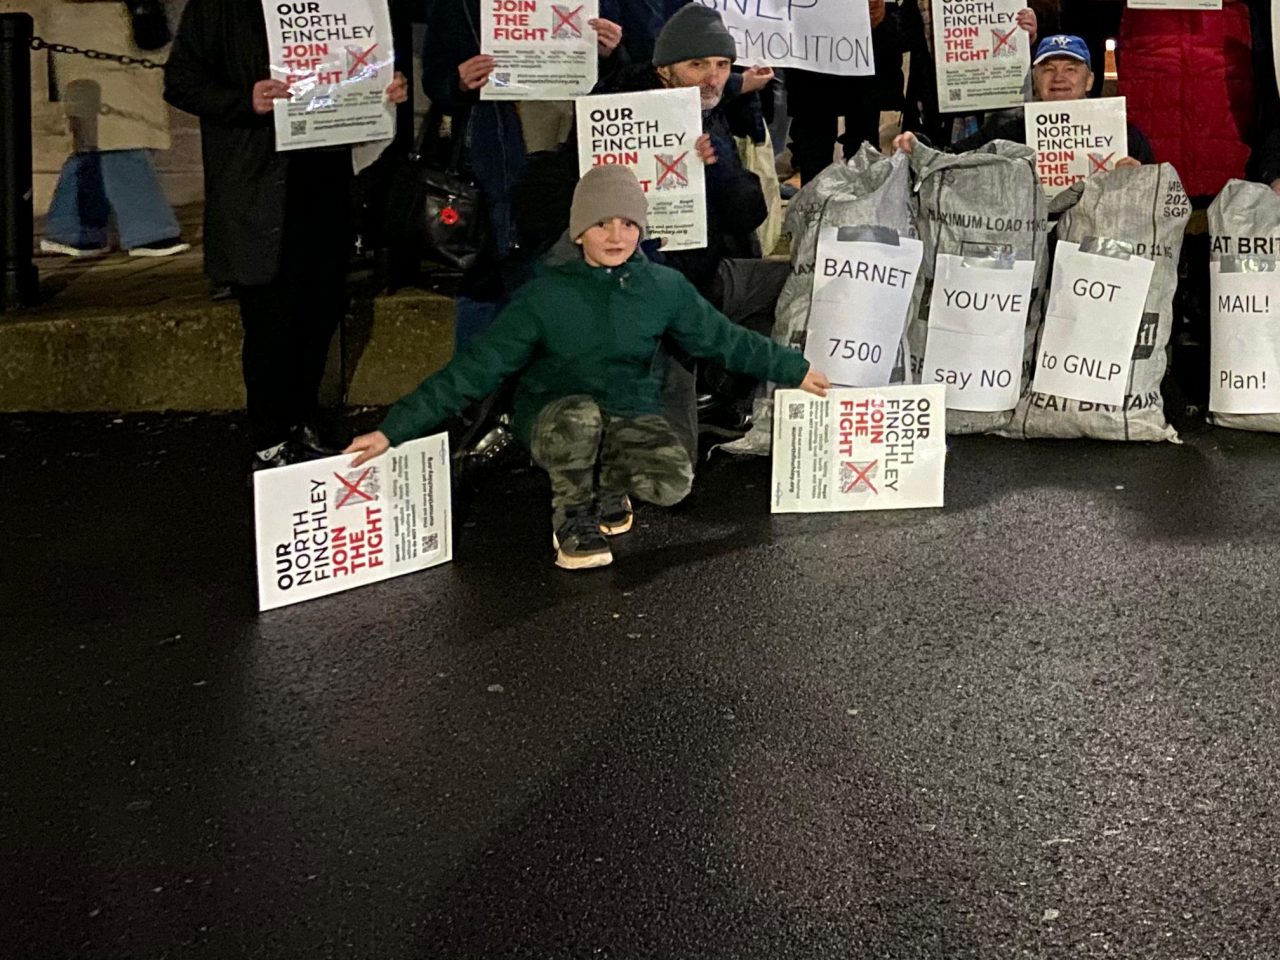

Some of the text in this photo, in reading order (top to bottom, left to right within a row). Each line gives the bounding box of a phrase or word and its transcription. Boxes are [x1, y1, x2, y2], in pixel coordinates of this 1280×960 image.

[277, 2, 320, 15] OUR
[493, 0, 536, 12] JOIN
[943, 2, 994, 15] NORTH
[280, 13, 347, 29] NORTH
[493, 14, 529, 26] THE
[944, 12, 1015, 27] FINCHLEY
[282, 25, 374, 43] FINCHLEY
[493, 28, 548, 41] FIGHT
[944, 27, 979, 39] JOIN
[282, 42, 329, 58] JOIN
[728, 26, 870, 68] EMOLITION
[944, 39, 974, 50] THE
[946, 49, 989, 63] FIGHT
[590, 108, 633, 123] OUR
[1036, 113, 1070, 126] OUR
[591, 120, 659, 137] NORTH
[1037, 124, 1091, 138] NORTH
[592, 132, 686, 152] FINCHLEY
[1037, 136, 1113, 151] FINCHLEY
[592, 152, 638, 166] JOIN
[1037, 150, 1074, 163] JOIN
[1037, 163, 1069, 175] THE
[986, 216, 1022, 232] LOAD
[823, 257, 912, 290] BARNET
[1072, 277, 1121, 303] GOT
[943, 288, 1022, 313] YOU'VE
[1218, 295, 1270, 313] MAIL!
[828, 338, 882, 364] 7500
[1041, 350, 1122, 382] to GNLP
[934, 368, 1012, 390] say NO
[1219, 370, 1267, 390] Plan!
[855, 399, 869, 437] THE
[870, 399, 885, 444] JOIN
[917, 398, 930, 439] OUR
[839, 401, 853, 456] FIGHT
[900, 399, 915, 464] NORTH
[884, 400, 900, 492] FINCHLEY
[311, 479, 331, 581] FINCHLEY
[366, 507, 384, 568] FIGHT
[293, 510, 312, 586] NORTH
[331, 526, 348, 577] JOIN
[349, 530, 366, 574] THE
[276, 542, 293, 591] OUR
